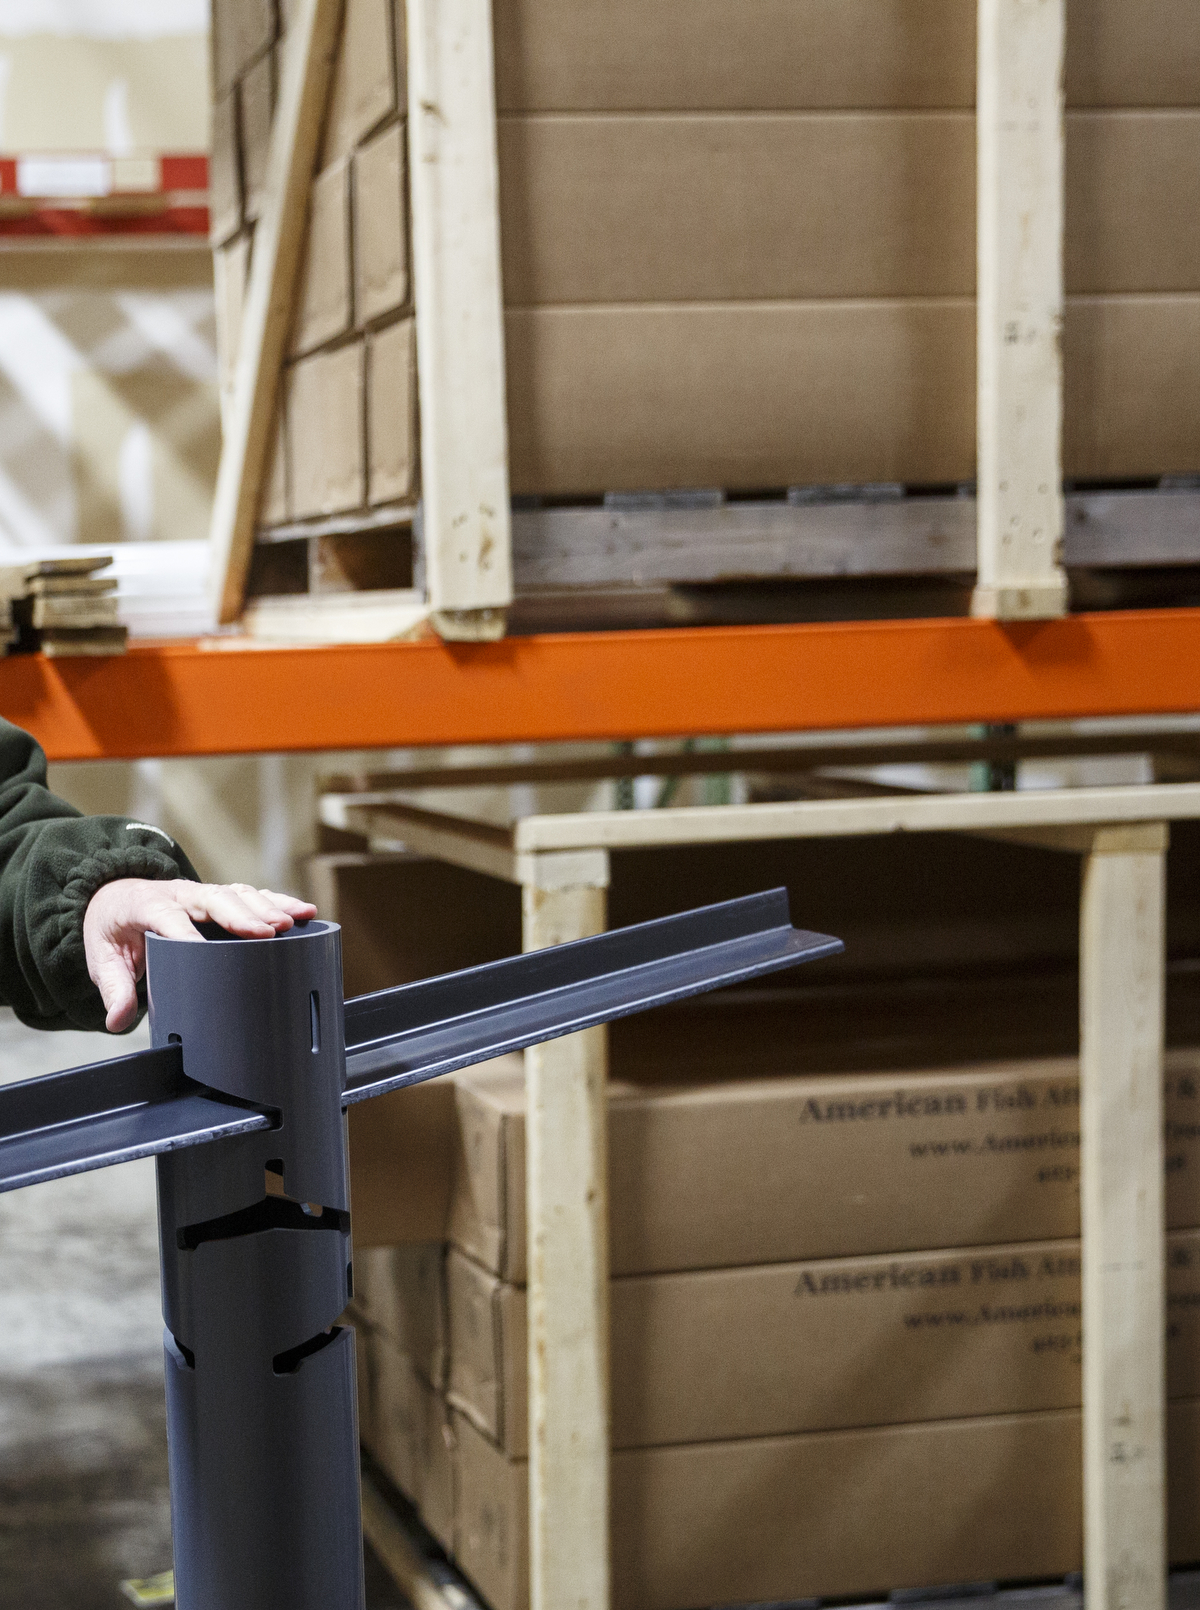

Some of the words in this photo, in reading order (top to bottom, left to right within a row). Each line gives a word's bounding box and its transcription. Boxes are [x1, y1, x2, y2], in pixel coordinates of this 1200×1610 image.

[799, 1090, 968, 1125] American
[976, 1083, 1035, 1114] Fish
[793, 1262, 961, 1297] American
[970, 1255, 1029, 1285] Fish
